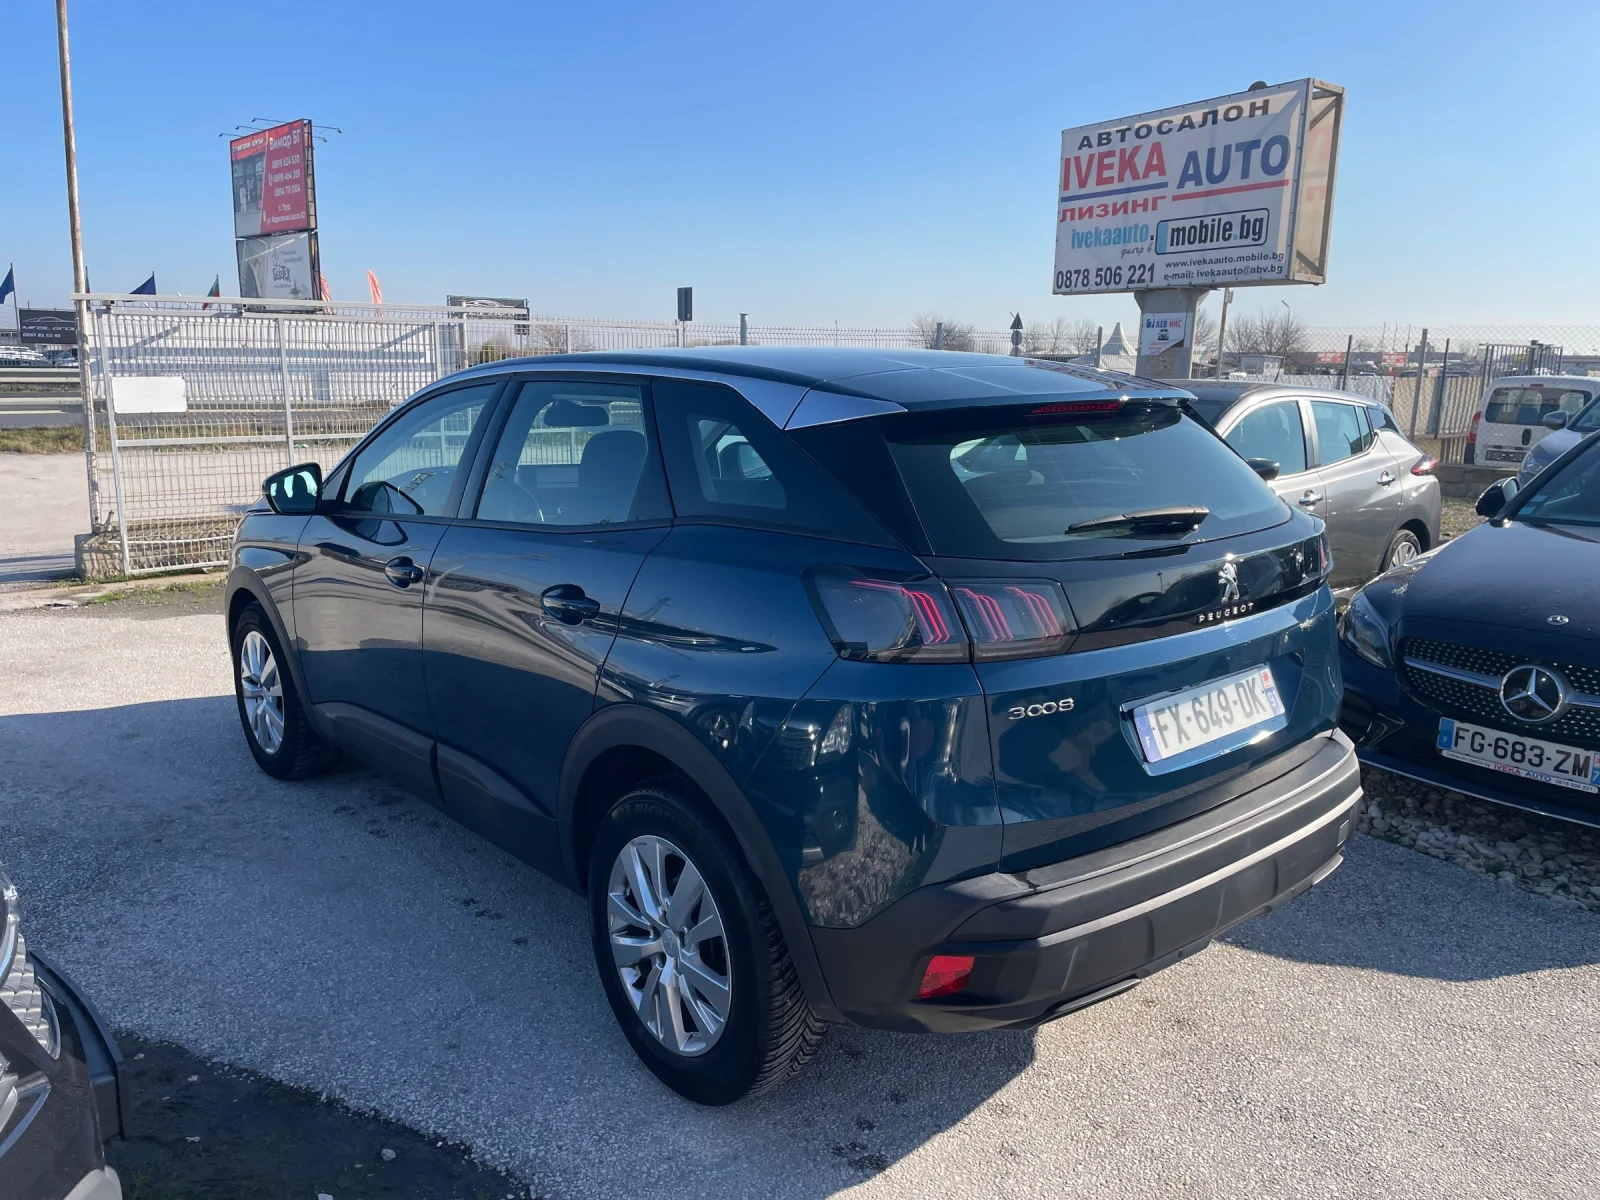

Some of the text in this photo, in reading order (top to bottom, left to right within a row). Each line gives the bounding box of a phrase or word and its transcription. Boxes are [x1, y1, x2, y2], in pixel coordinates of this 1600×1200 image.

[1077, 98, 1271, 151] АВТОСАЛОН
[1062, 135, 1291, 191] IVEKA AUTO
[1059, 195, 1167, 223] ЛИЗИНГ
[1169, 214, 1264, 247] mobile.bg
[1163, 264, 1283, 281] e-mail: ivekaauto@abv.bg
[1165, 251, 1284, 269] www.ivekaauto.mobile.bg
[1056, 262, 1155, 289] 0878 506 221
[1198, 602, 1255, 623] PEUGEOT
[1007, 697, 1075, 720] 3008
[1153, 677, 1268, 749] FX-649-DK
[1453, 726, 1591, 779] FG-683-ZM
[1493, 763, 1522, 775] IVEKA
[1525, 771, 1552, 782] AUTO
